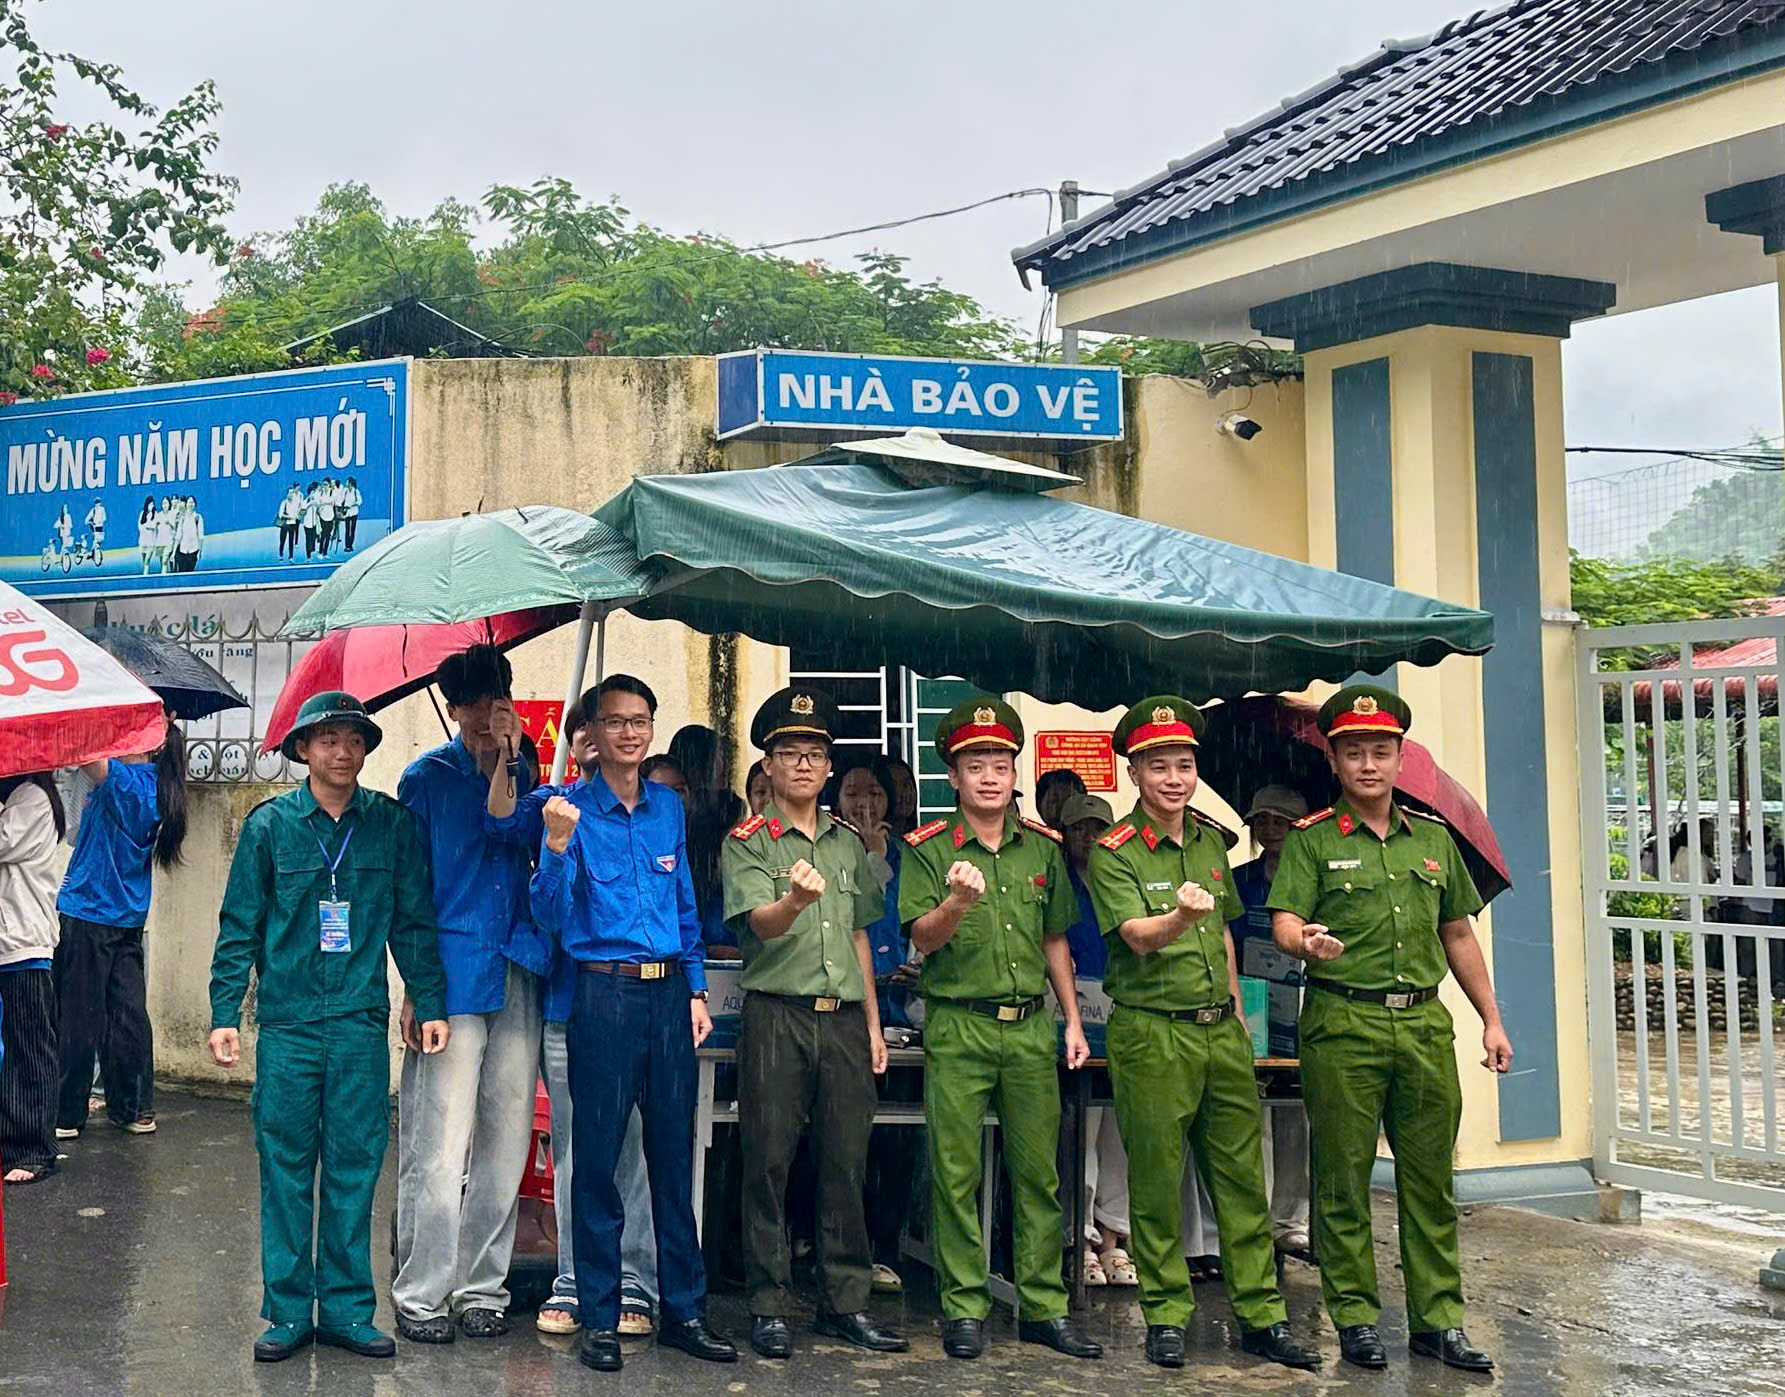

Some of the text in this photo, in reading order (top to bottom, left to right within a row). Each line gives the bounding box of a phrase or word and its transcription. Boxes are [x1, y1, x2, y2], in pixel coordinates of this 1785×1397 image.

[779, 365, 1100, 431] NHÀ BẢO VỆ
[7, 396, 367, 495] MỪNG NĂM HỌC MỚI
